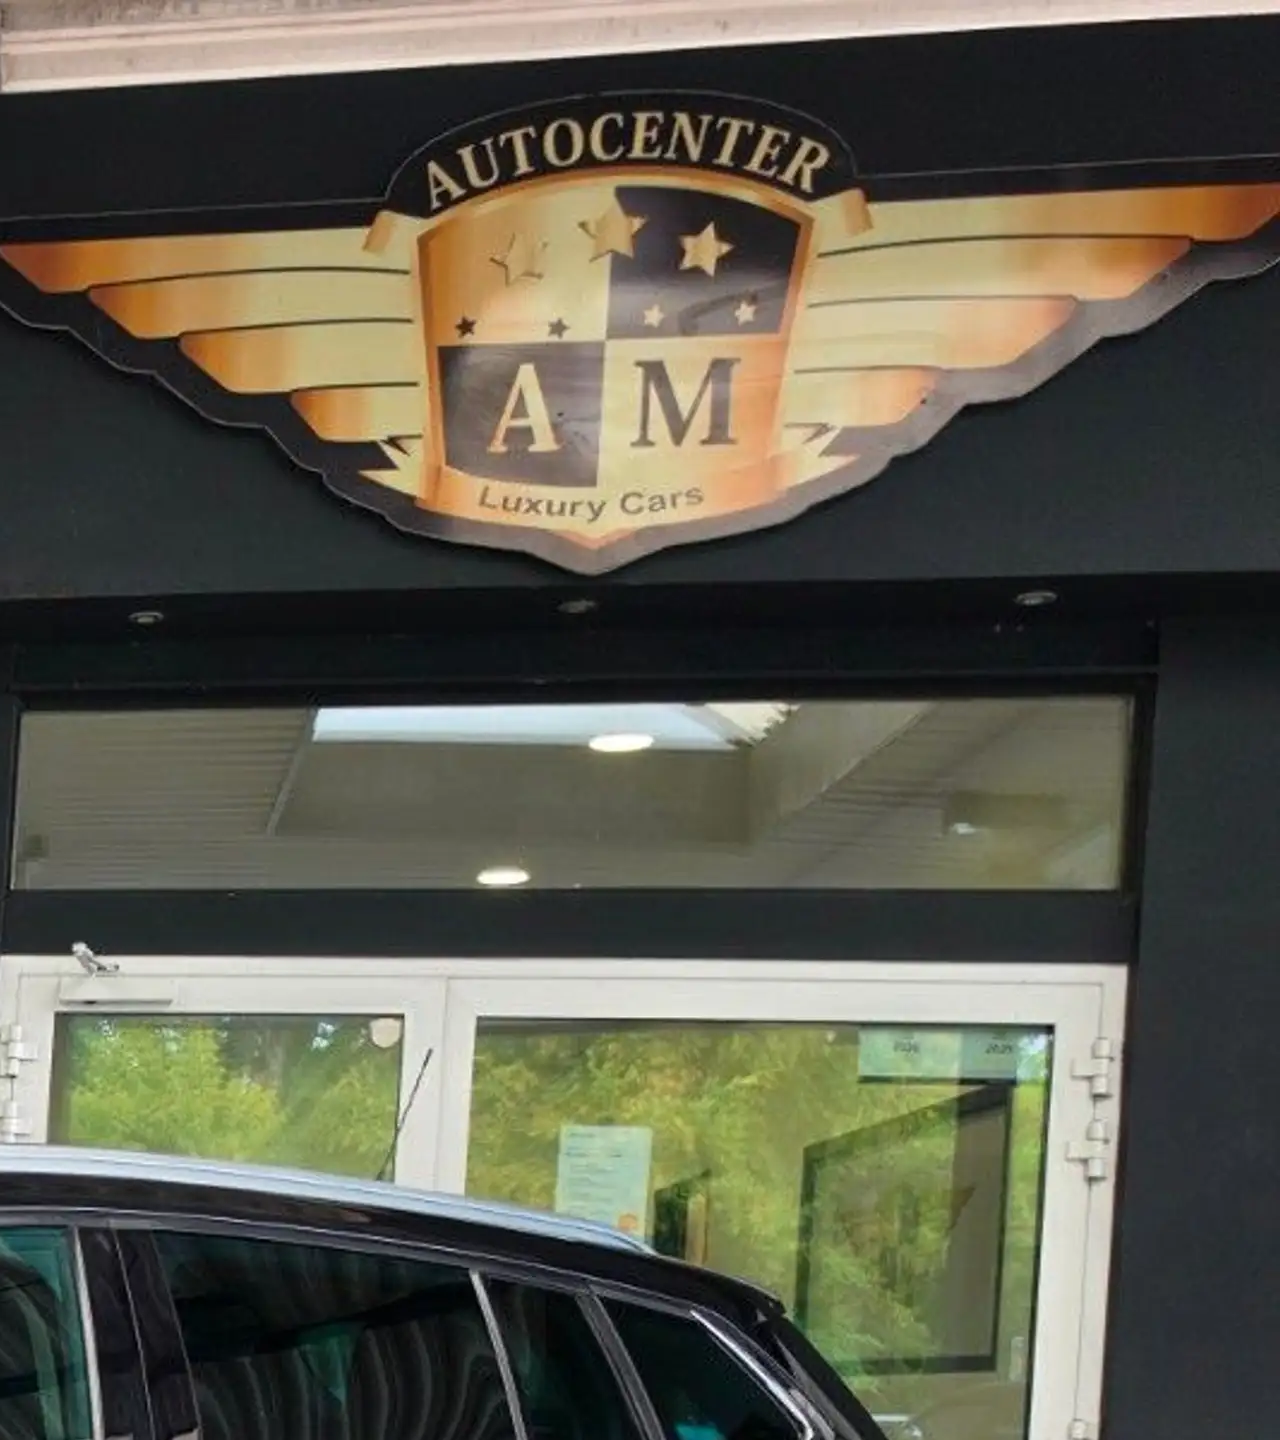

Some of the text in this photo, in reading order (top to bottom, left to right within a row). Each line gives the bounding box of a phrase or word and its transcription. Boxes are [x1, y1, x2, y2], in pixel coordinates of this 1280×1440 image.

[424, 111, 831, 210] AUTOCENTER
[486, 356, 742, 454] A M
[478, 485, 705, 524] Luxury Cars
